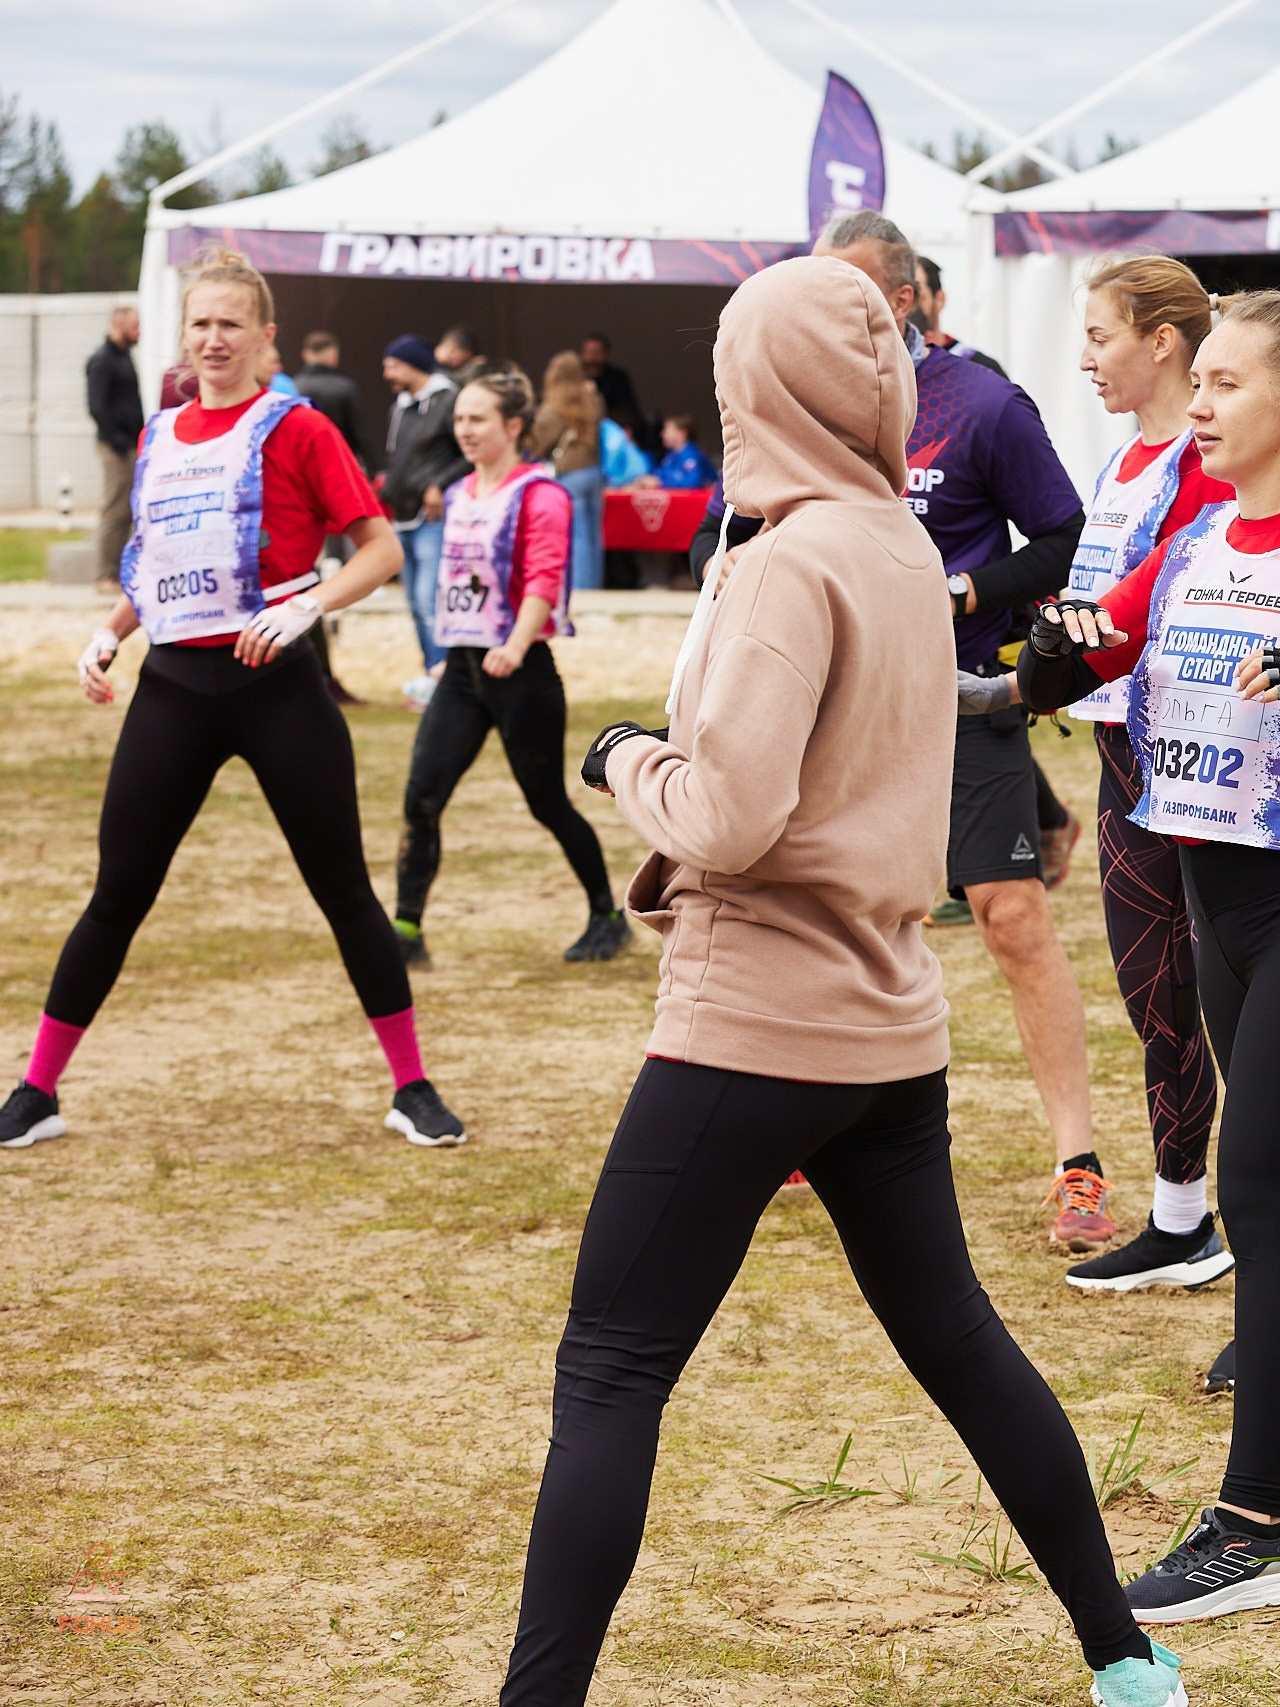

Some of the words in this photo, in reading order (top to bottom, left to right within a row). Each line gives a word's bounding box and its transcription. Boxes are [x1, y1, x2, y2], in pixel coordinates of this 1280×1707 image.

[318, 232, 655, 280] ГРАВИРОВКА
[157, 568, 219, 603] 03205
[1185, 588, 1223, 601] ГОНКА
[1181, 656, 1233, 683] СТАРТ
[1154, 737, 1244, 789] 03202
[1162, 800, 1237, 825] ГАЗПРОМБАНК
